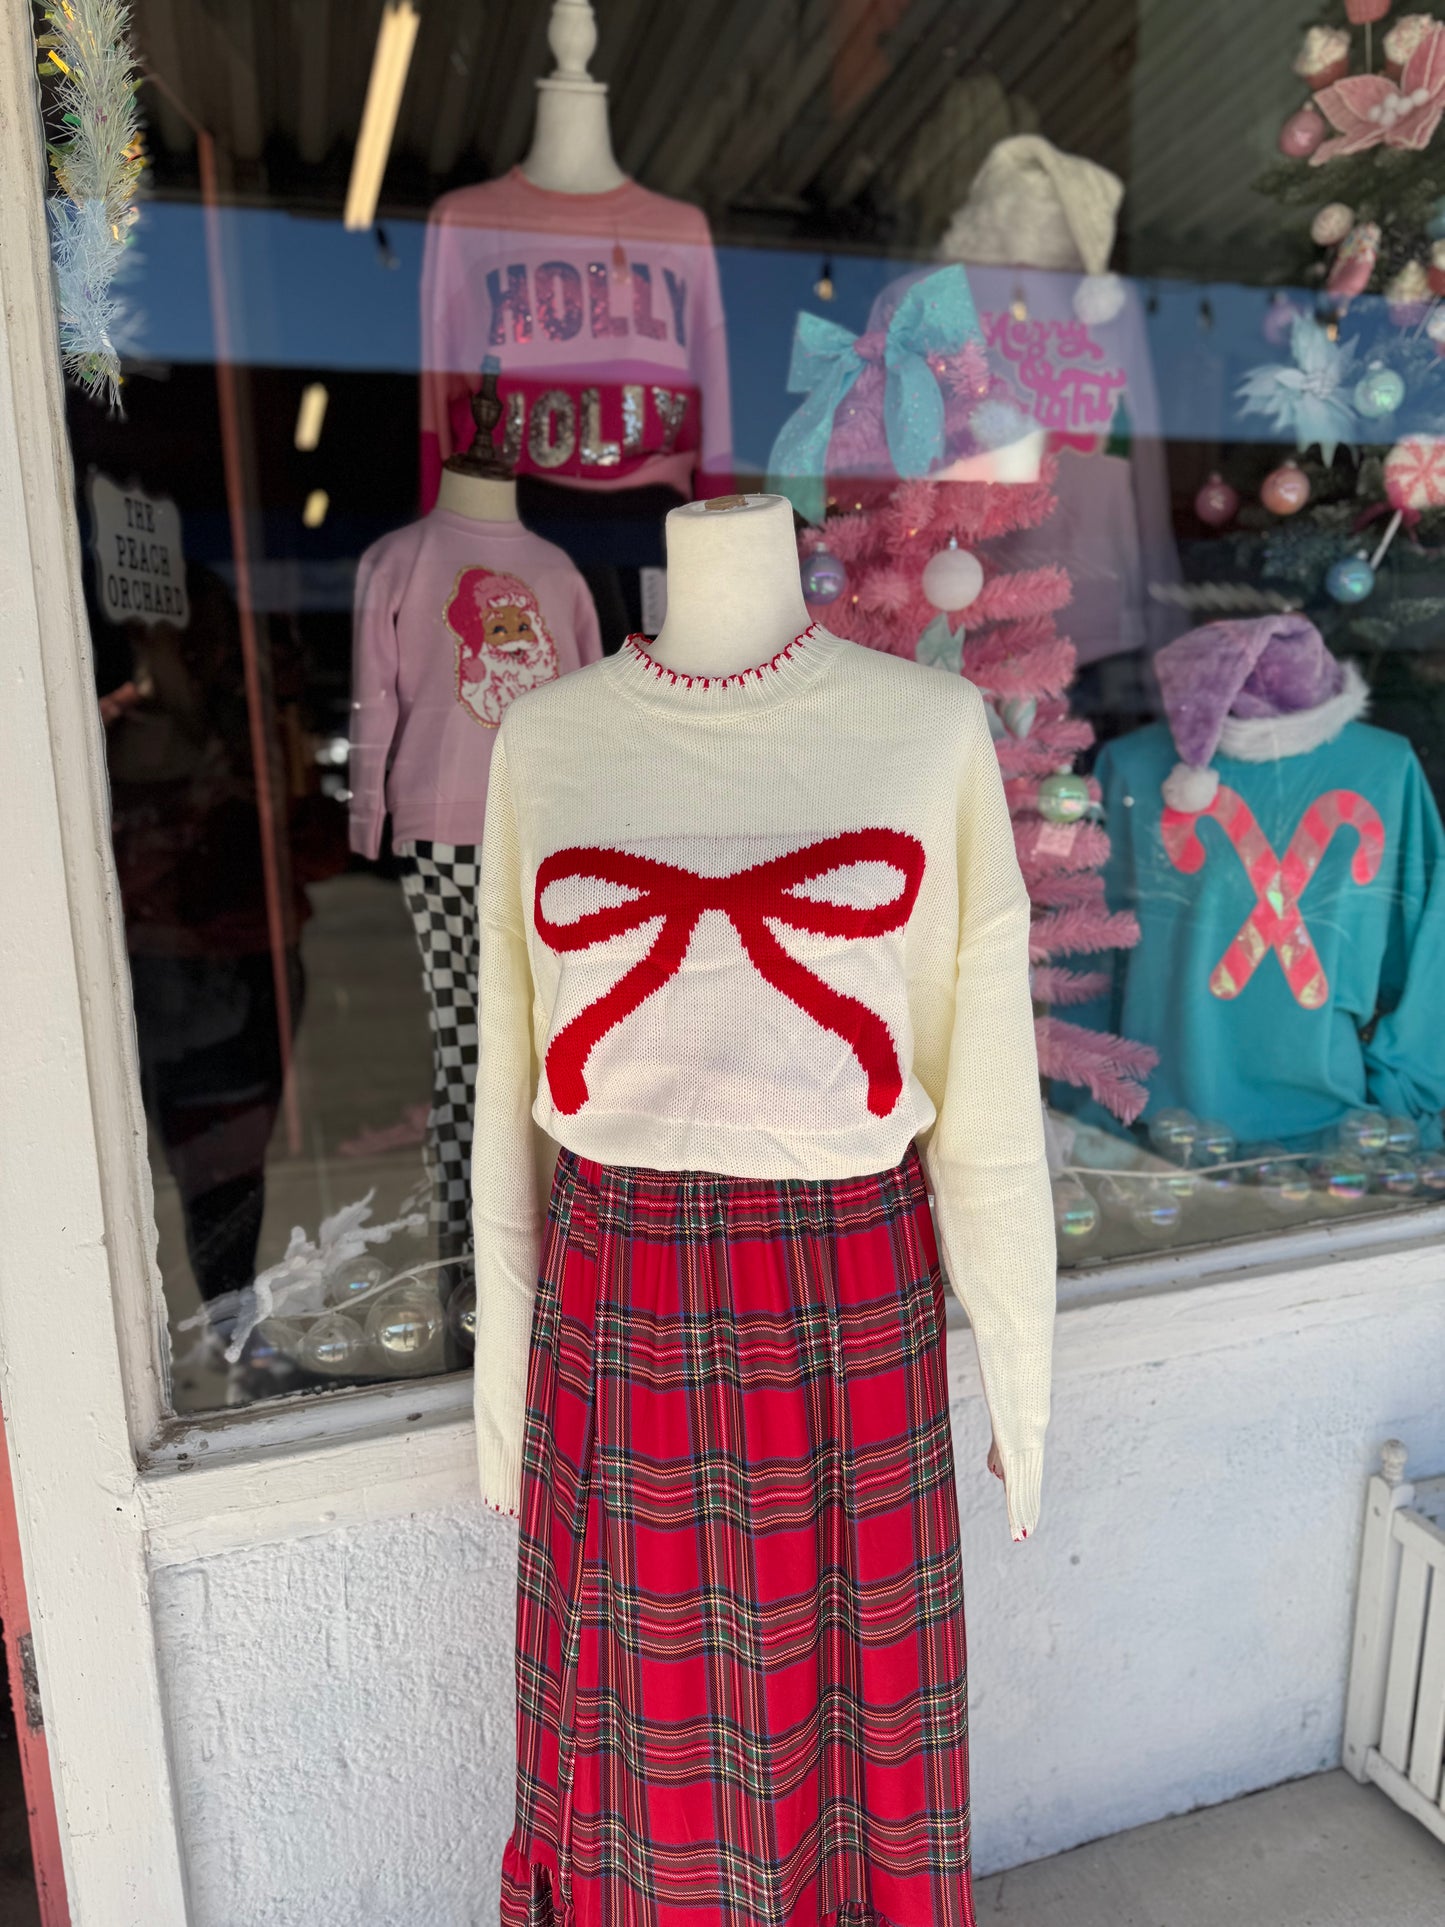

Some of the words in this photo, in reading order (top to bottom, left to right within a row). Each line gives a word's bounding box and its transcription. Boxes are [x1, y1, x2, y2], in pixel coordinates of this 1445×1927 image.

[485, 260, 688, 347] HOLLY
[979, 311, 1105, 362] Merry
[501, 384, 688, 468] JOLLY
[124, 497, 155, 533] THE
[115, 533, 171, 577] PEACH
[107, 573, 182, 617] ORCHARD
